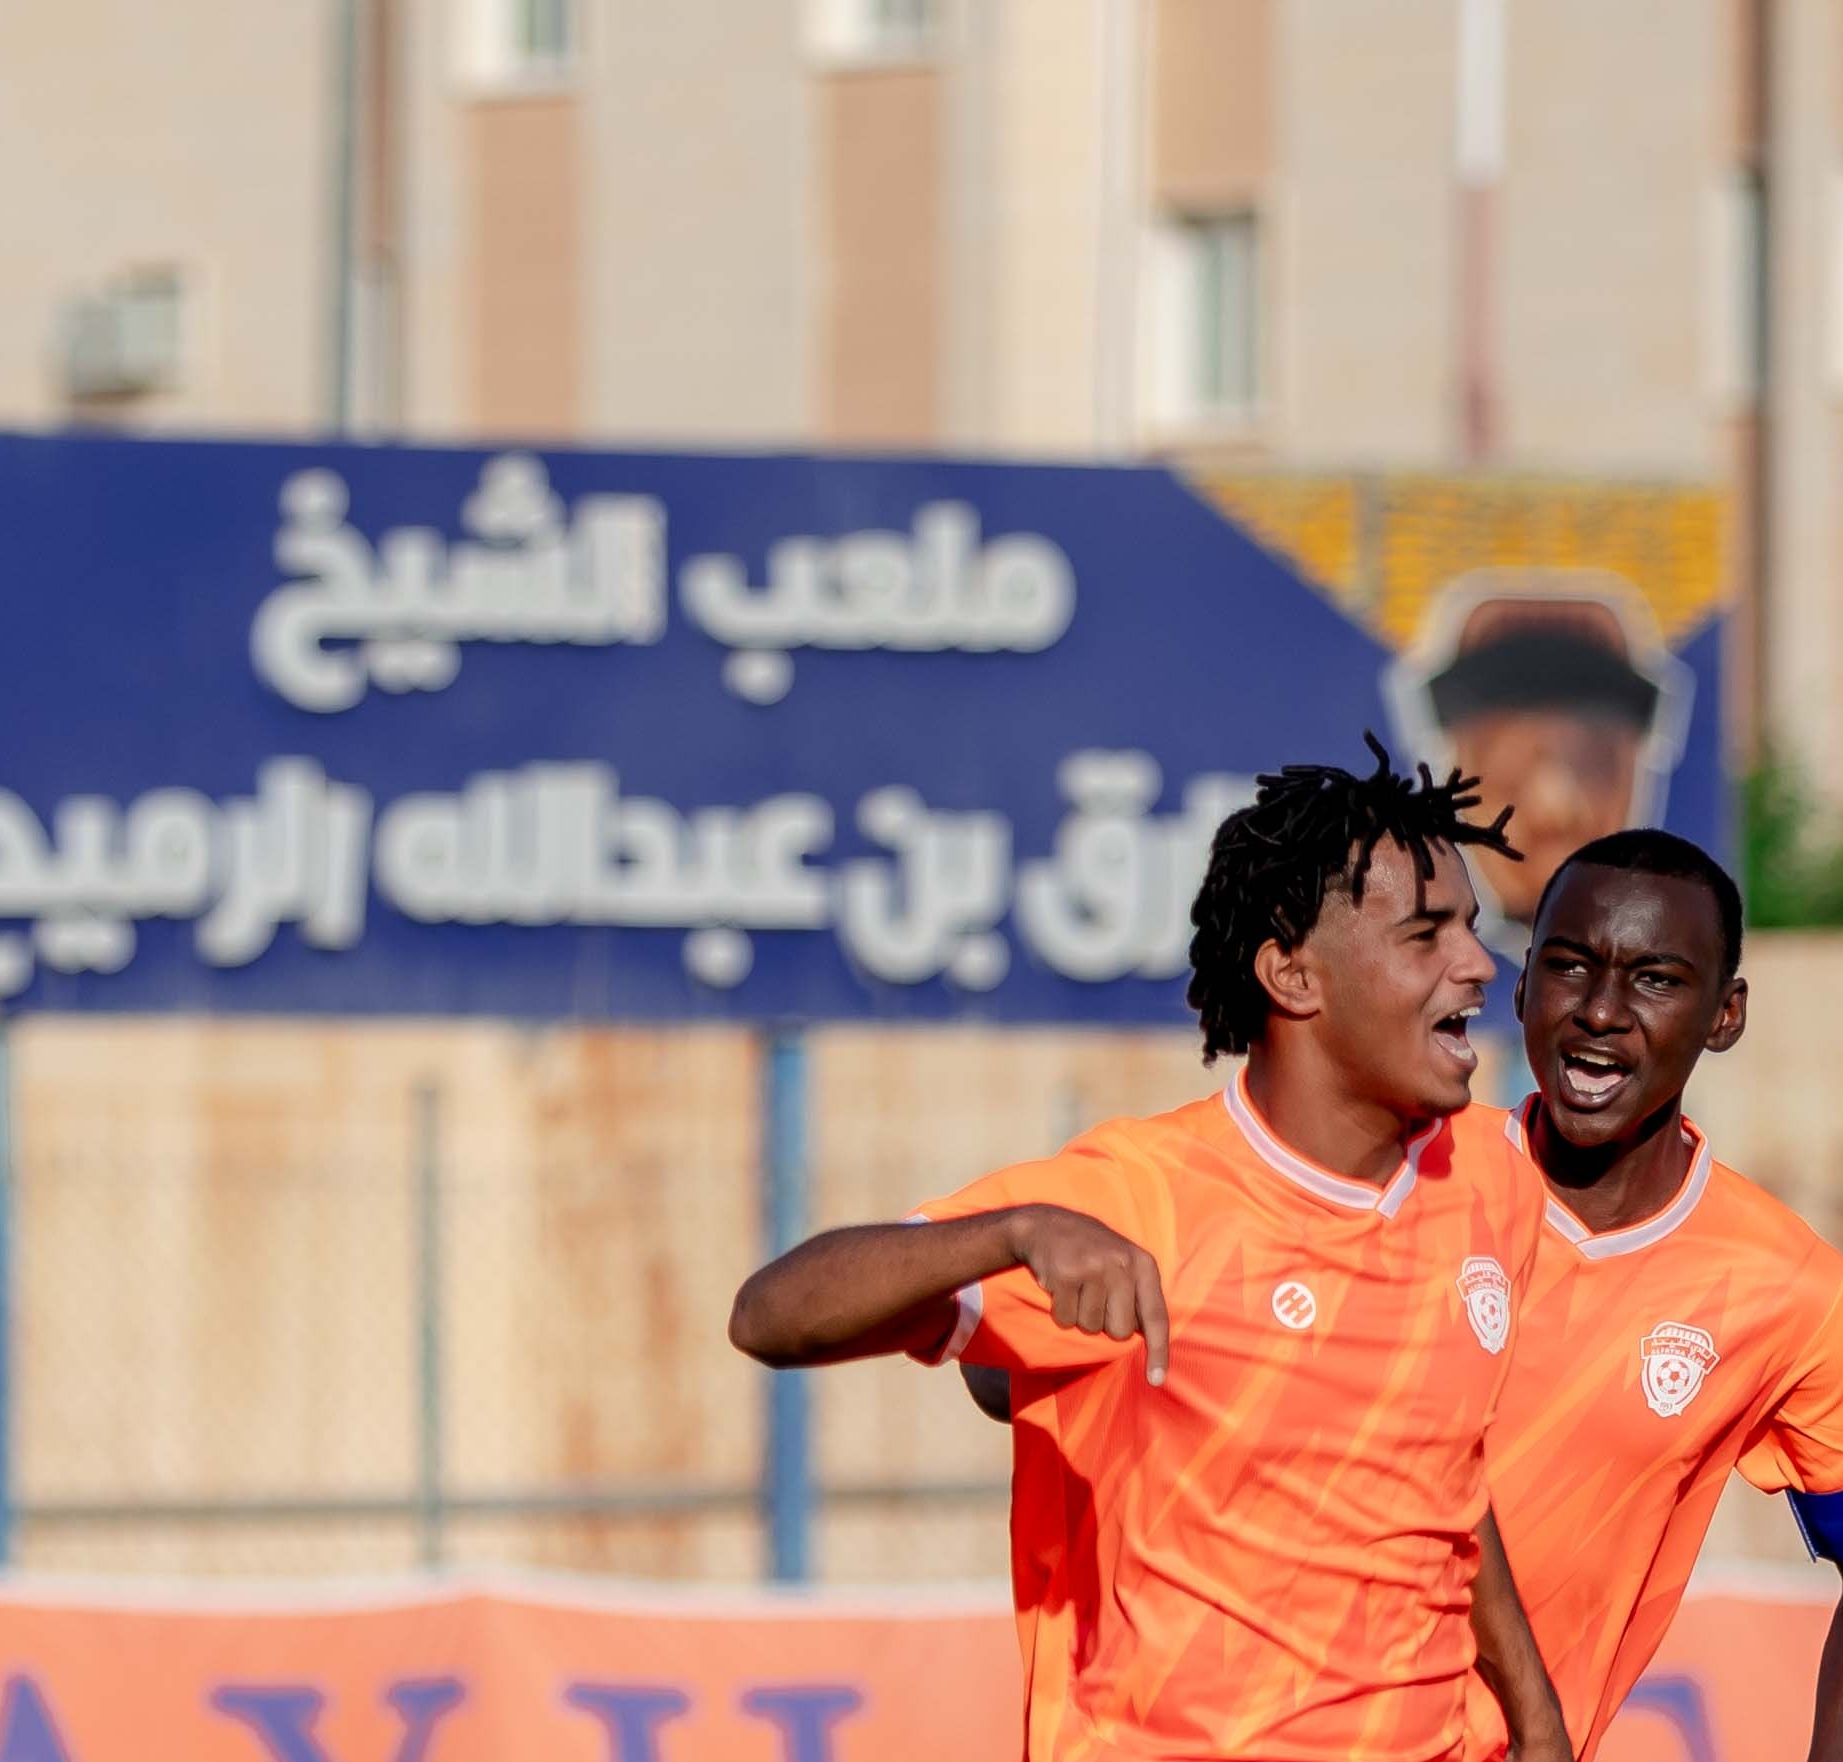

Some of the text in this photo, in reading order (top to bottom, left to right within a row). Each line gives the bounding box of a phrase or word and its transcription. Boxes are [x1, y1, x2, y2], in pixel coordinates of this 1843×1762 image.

[251, 455, 1078, 712] ملعب الشيخ
[376, 756, 835, 988] عبدالله
[840, 785, 1010, 990] بن
